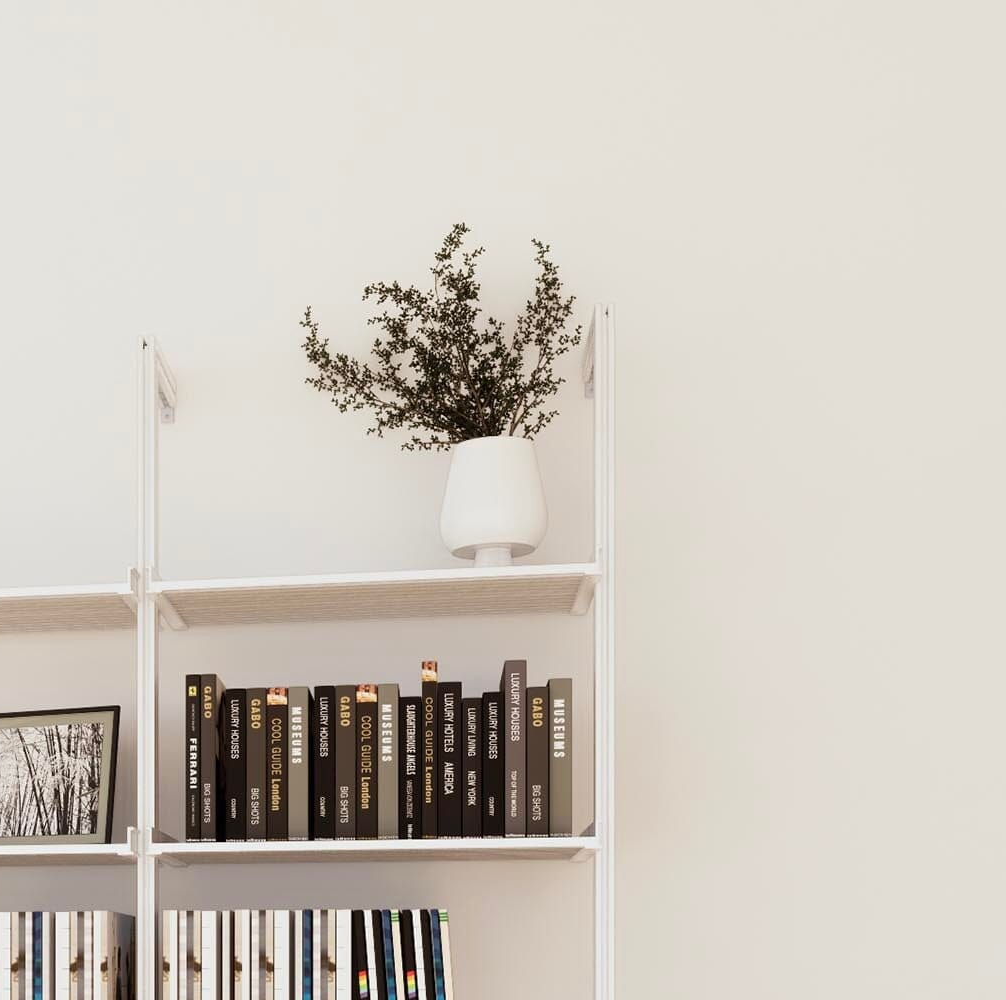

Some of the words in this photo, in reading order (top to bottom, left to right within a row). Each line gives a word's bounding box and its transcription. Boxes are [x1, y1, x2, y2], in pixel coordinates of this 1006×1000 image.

[204, 686, 212, 719] GABO
[510, 673, 520, 705] LUXURY
[231, 699, 239, 728] LUXURY
[251, 699, 261, 729] GABO
[320, 697, 328, 726] LUXURY
[340, 696, 350, 727] GABO
[425, 697, 433, 726] COOL
[444, 693, 454, 722] LUXURY
[468, 708, 476, 734] LUXURY
[489, 702, 497, 730] LUXURY
[532, 697, 543, 727] GABO
[272, 718, 281, 744] COOL
[291, 706, 302, 764] MUSEUMS
[362, 716, 371, 742] COOL
[382, 704, 392, 762] MUSEUMS
[406, 705, 415, 753] SLAUGHTERHOUSE
[444, 724, 454, 753] HOTELS
[510, 707, 520, 741] HOUSES
[554, 699, 565, 758] MUSEUMS
[231, 730, 239, 759] HOUSES
[320, 728, 328, 757] HOUSES
[425, 730, 433, 763] GUIDE
[467, 736, 476, 756] LIVING
[489, 731, 497, 759] HOUSES
[272, 747, 281, 775] GUIDE
[361, 745, 371, 773] GUIDE
[406, 754, 415, 775] ANGELS
[340, 786, 348, 798] BIG
[361, 777, 371, 809] London
[425, 766, 433, 803] London
[444, 762, 454, 795] AMERICA
[468, 771, 476, 786] NEW
[533, 785, 541, 796] BIG
[251, 788, 259, 800] BIG
[272, 779, 281, 811] London
[468, 787, 476, 806] YORK
[251, 801, 259, 825] SHOTS
[340, 800, 348, 823] SHOTS
[532, 798, 541, 821] SHOTS
